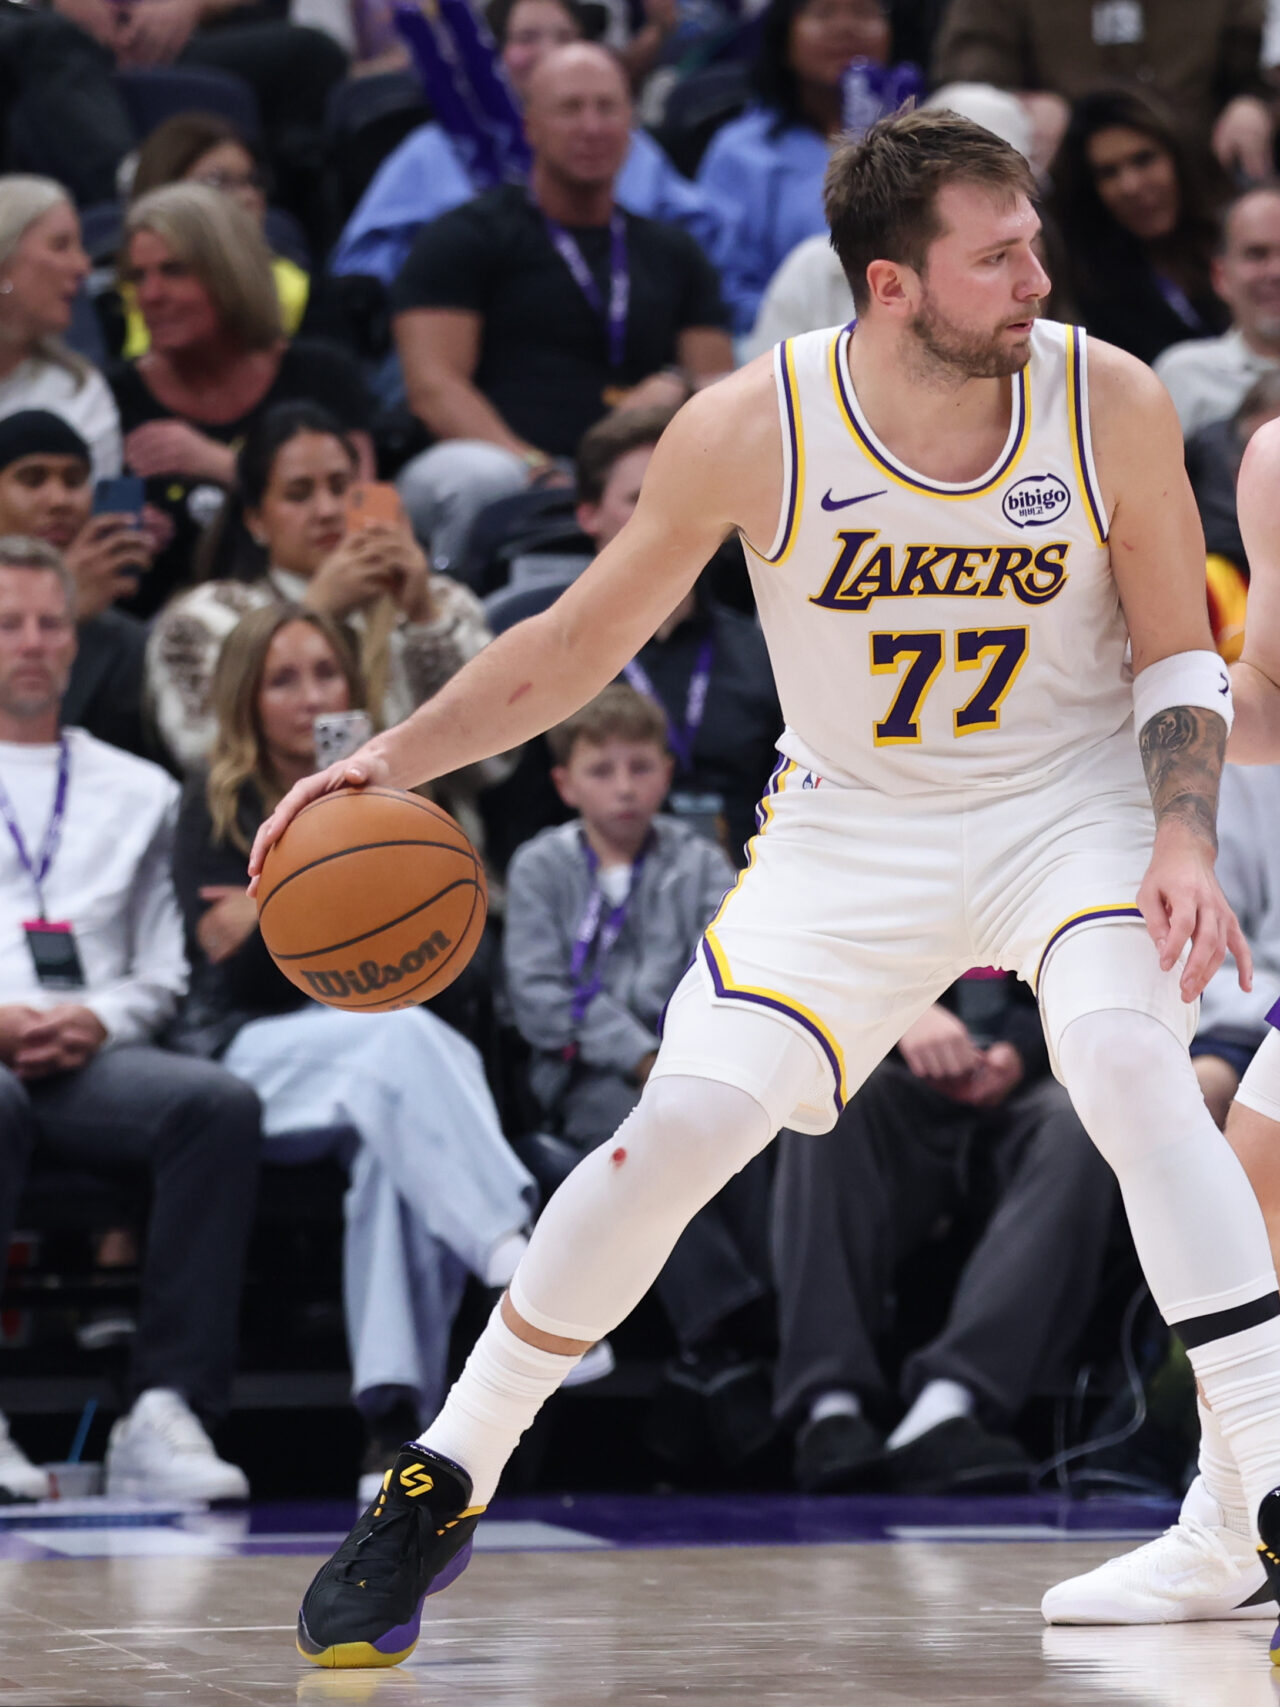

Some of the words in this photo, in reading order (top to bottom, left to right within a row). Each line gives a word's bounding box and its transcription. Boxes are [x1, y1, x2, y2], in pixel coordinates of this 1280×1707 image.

[1008, 488, 1066, 510] bibigo
[1019, 506, 1044, 517] 비비고
[808, 528, 1070, 612] LAKERS
[868, 625, 1029, 748] 77
[300, 929, 452, 998] Wilson
